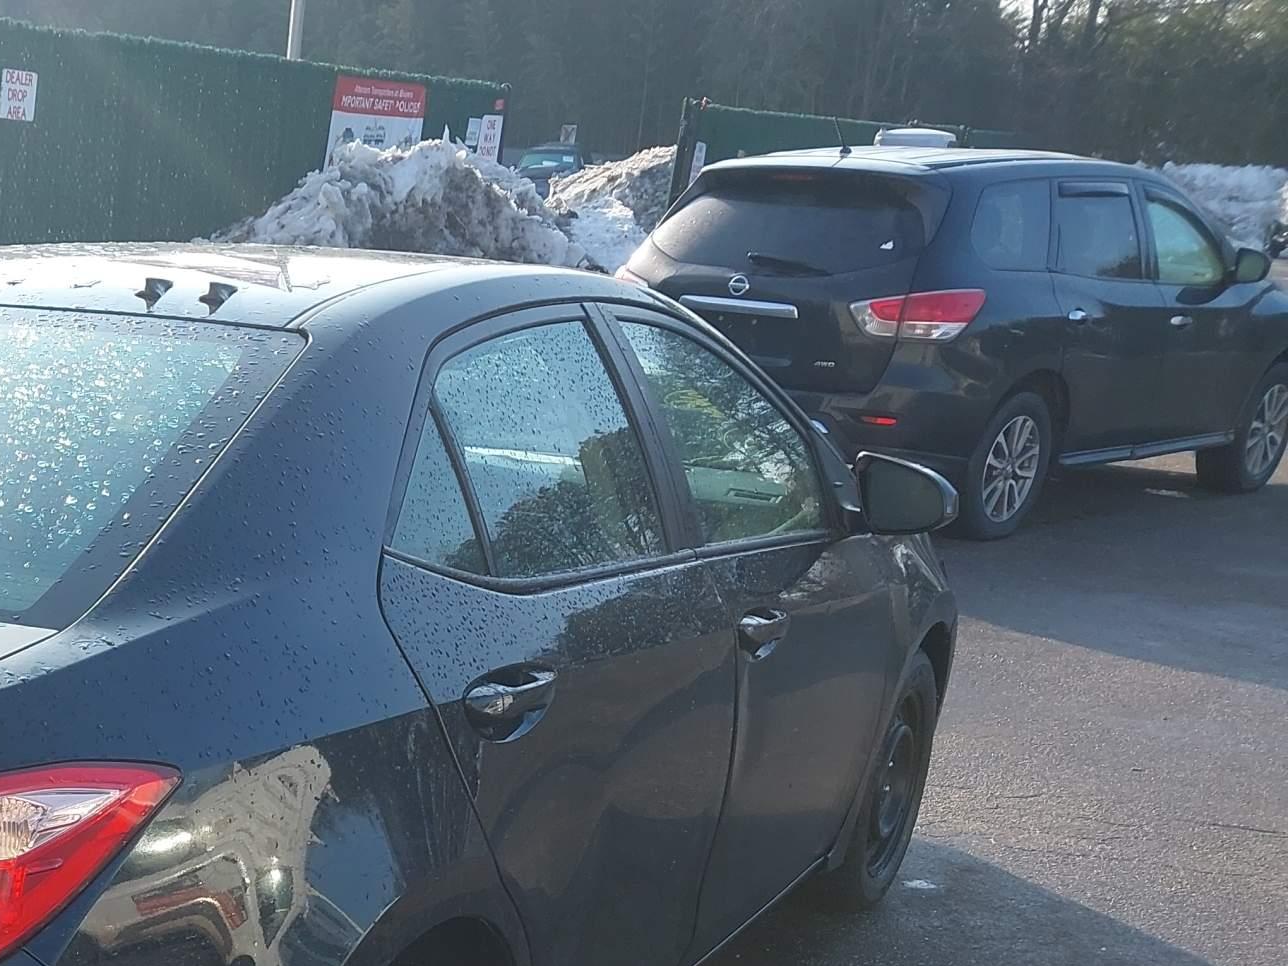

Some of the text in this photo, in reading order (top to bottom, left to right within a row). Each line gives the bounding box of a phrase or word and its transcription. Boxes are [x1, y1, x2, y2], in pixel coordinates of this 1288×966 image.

[5, 71, 33, 86] DEALER
[7, 88, 28, 102] DROP
[7, 106, 26, 120] AREA
